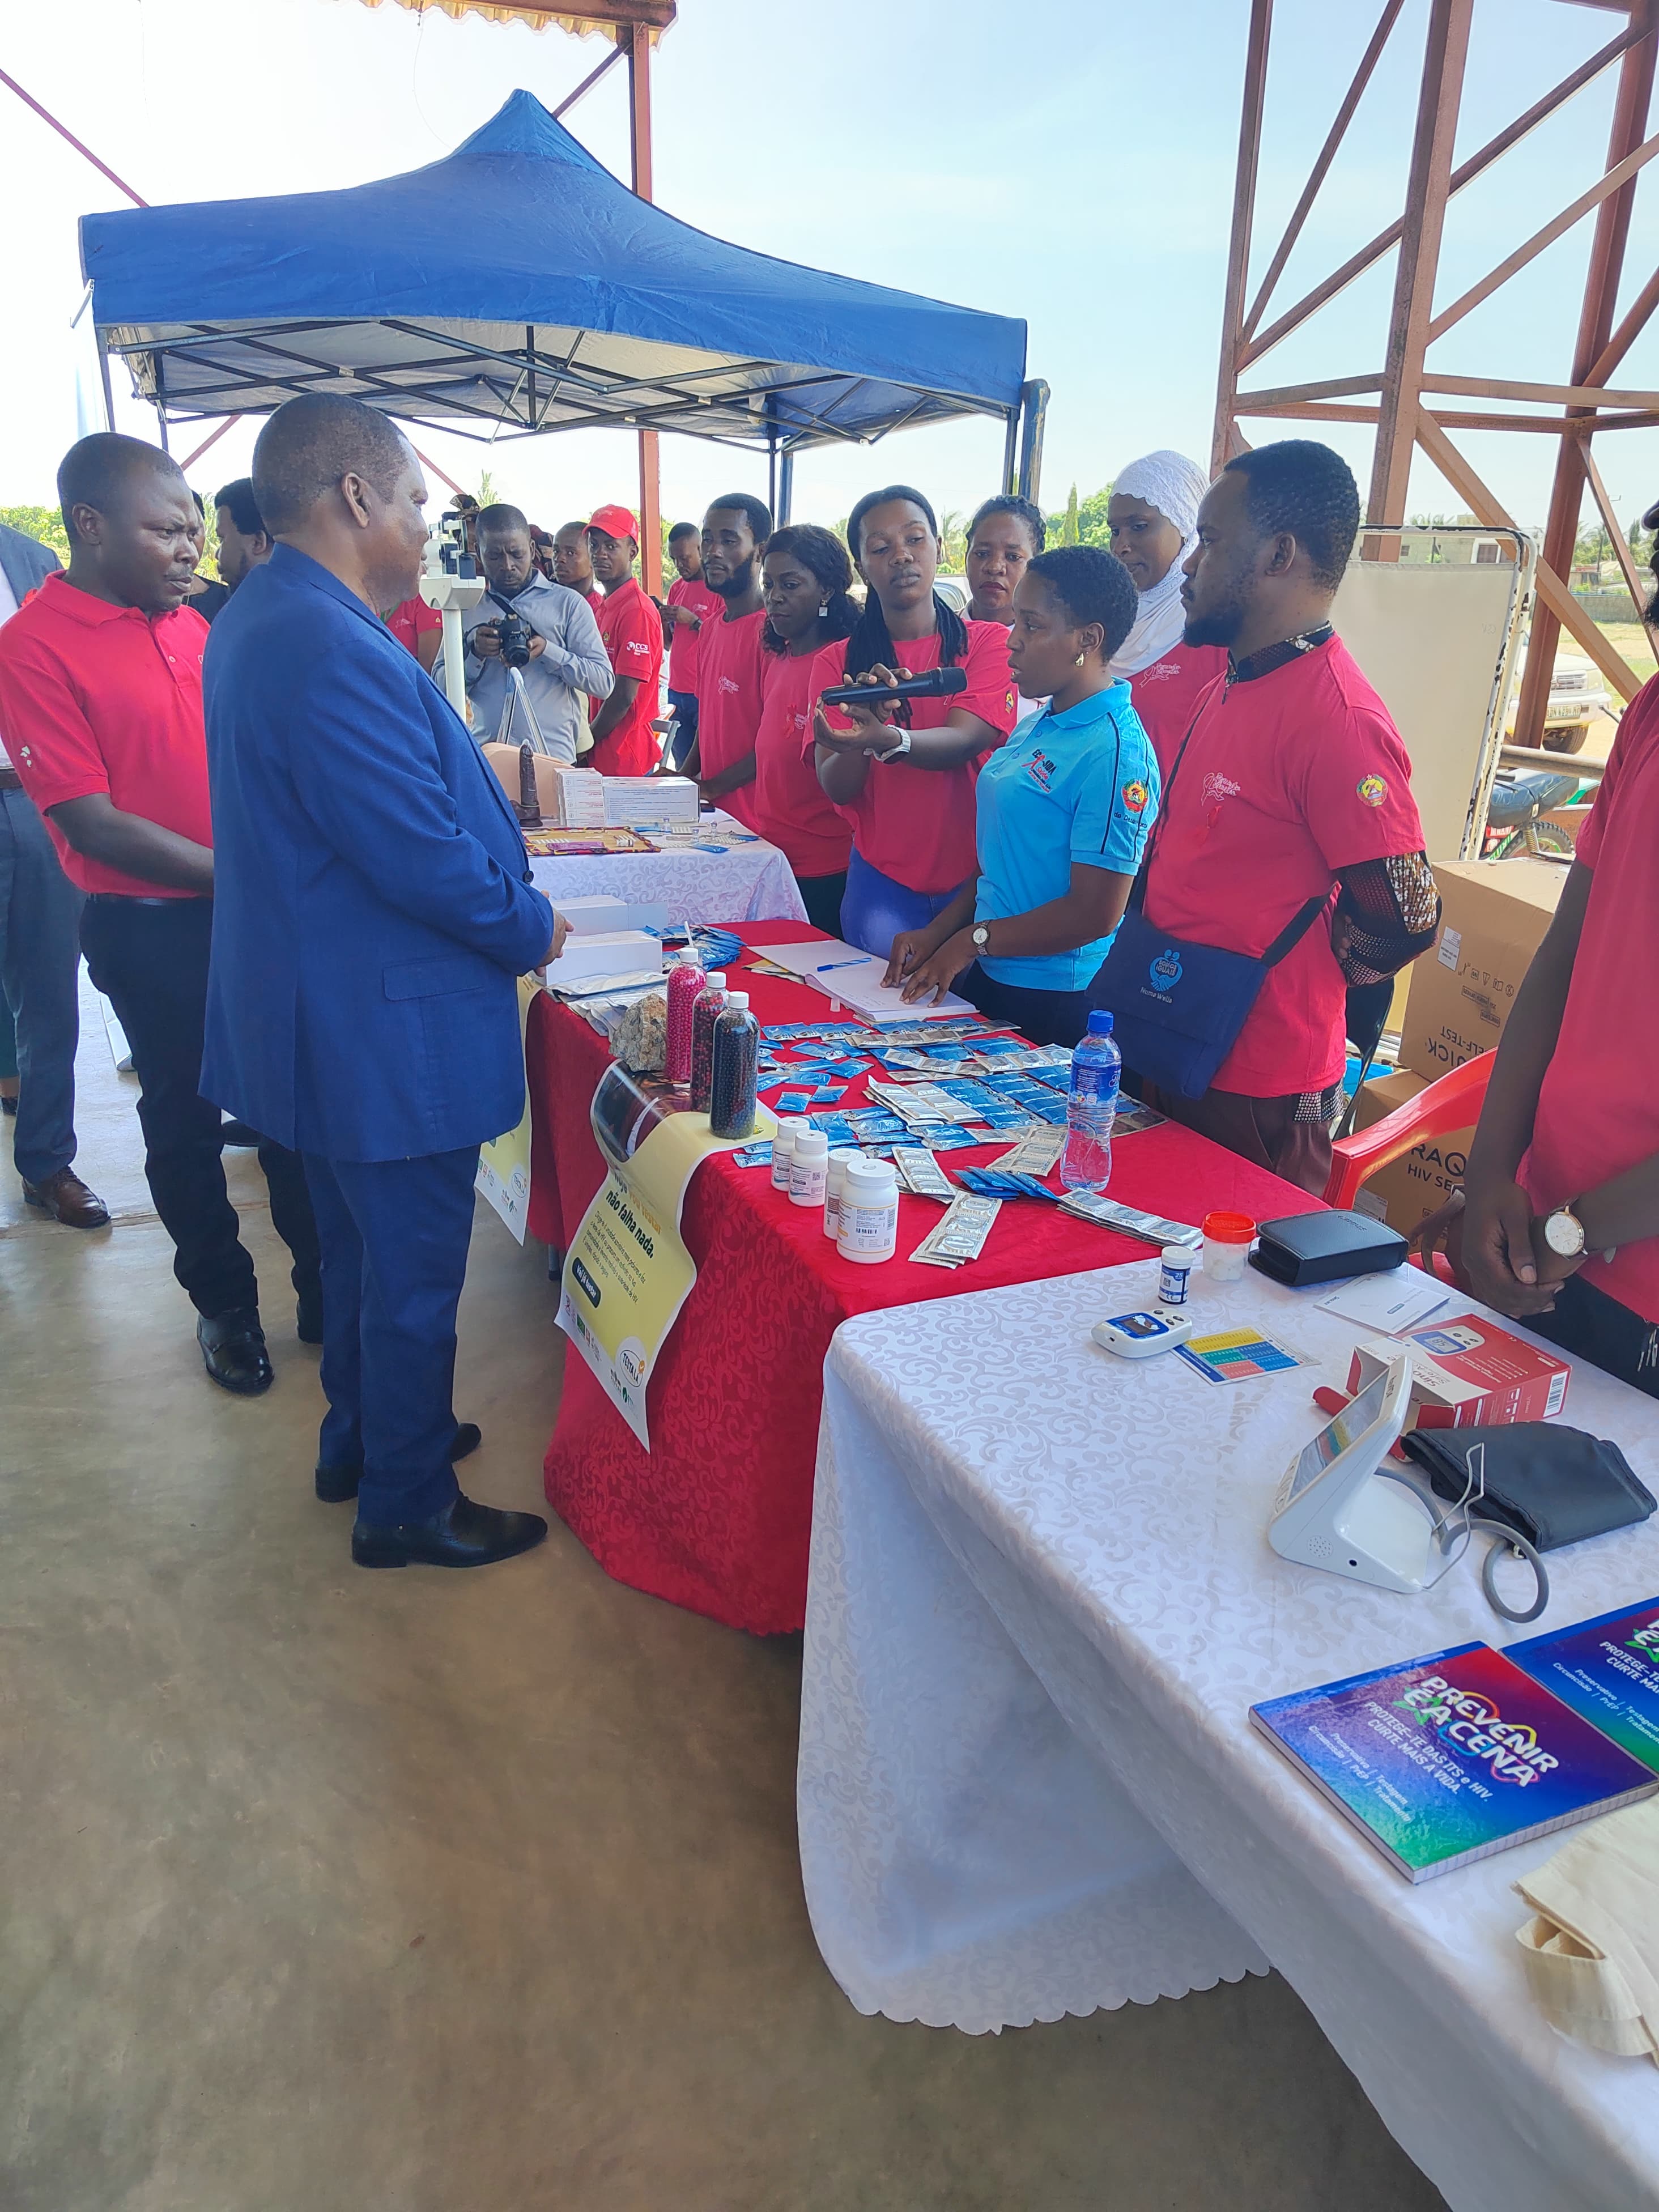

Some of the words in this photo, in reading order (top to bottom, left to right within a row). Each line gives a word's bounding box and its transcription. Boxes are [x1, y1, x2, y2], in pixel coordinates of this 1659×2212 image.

[1156, 964, 1176, 976] IGUAIS
[1428, 1037, 1466, 1067] UICK
[1441, 1026, 1488, 1054] ELF-TEST
[1407, 1163, 1432, 1181] HIV
[606, 1190, 620, 1211] não
[618, 1203, 636, 1232] falha
[635, 1227, 655, 1258] nada.
[1553, 1662, 1593, 1692] Circuncisão
[1600, 1697, 1619, 1710] PrEP
[1575, 1669, 1618, 1701] Preservativo
[1606, 1657, 1643, 1681] CURTE
[1640, 1678, 1659, 1695] MA
[1420, 1705, 1452, 1726] A
[1449, 1721, 1537, 1787] CENA
[1421, 1675, 1559, 1773] PREVENIR
[1330, 1733, 1370, 1768] Preservativo
[1376, 1774, 1409, 1805] Testagem
[1364, 1701, 1427, 1749] PROTEGE-TE
[1424, 1744, 1445, 1764] DAS
[1442, 1759, 1465, 1779] ITS
[1460, 1775, 1470, 1785] e
[1469, 1780, 1494, 1802] HIV.
[1367, 1718, 1398, 1745] CURTE
[1397, 1742, 1428, 1766] MAIS
[1423, 1761, 1435, 1773] A
[1433, 1768, 1462, 1794] VIDA.
[1350, 1764, 1369, 1780] PrEP
[1373, 1785, 1411, 1822] Tratamento
